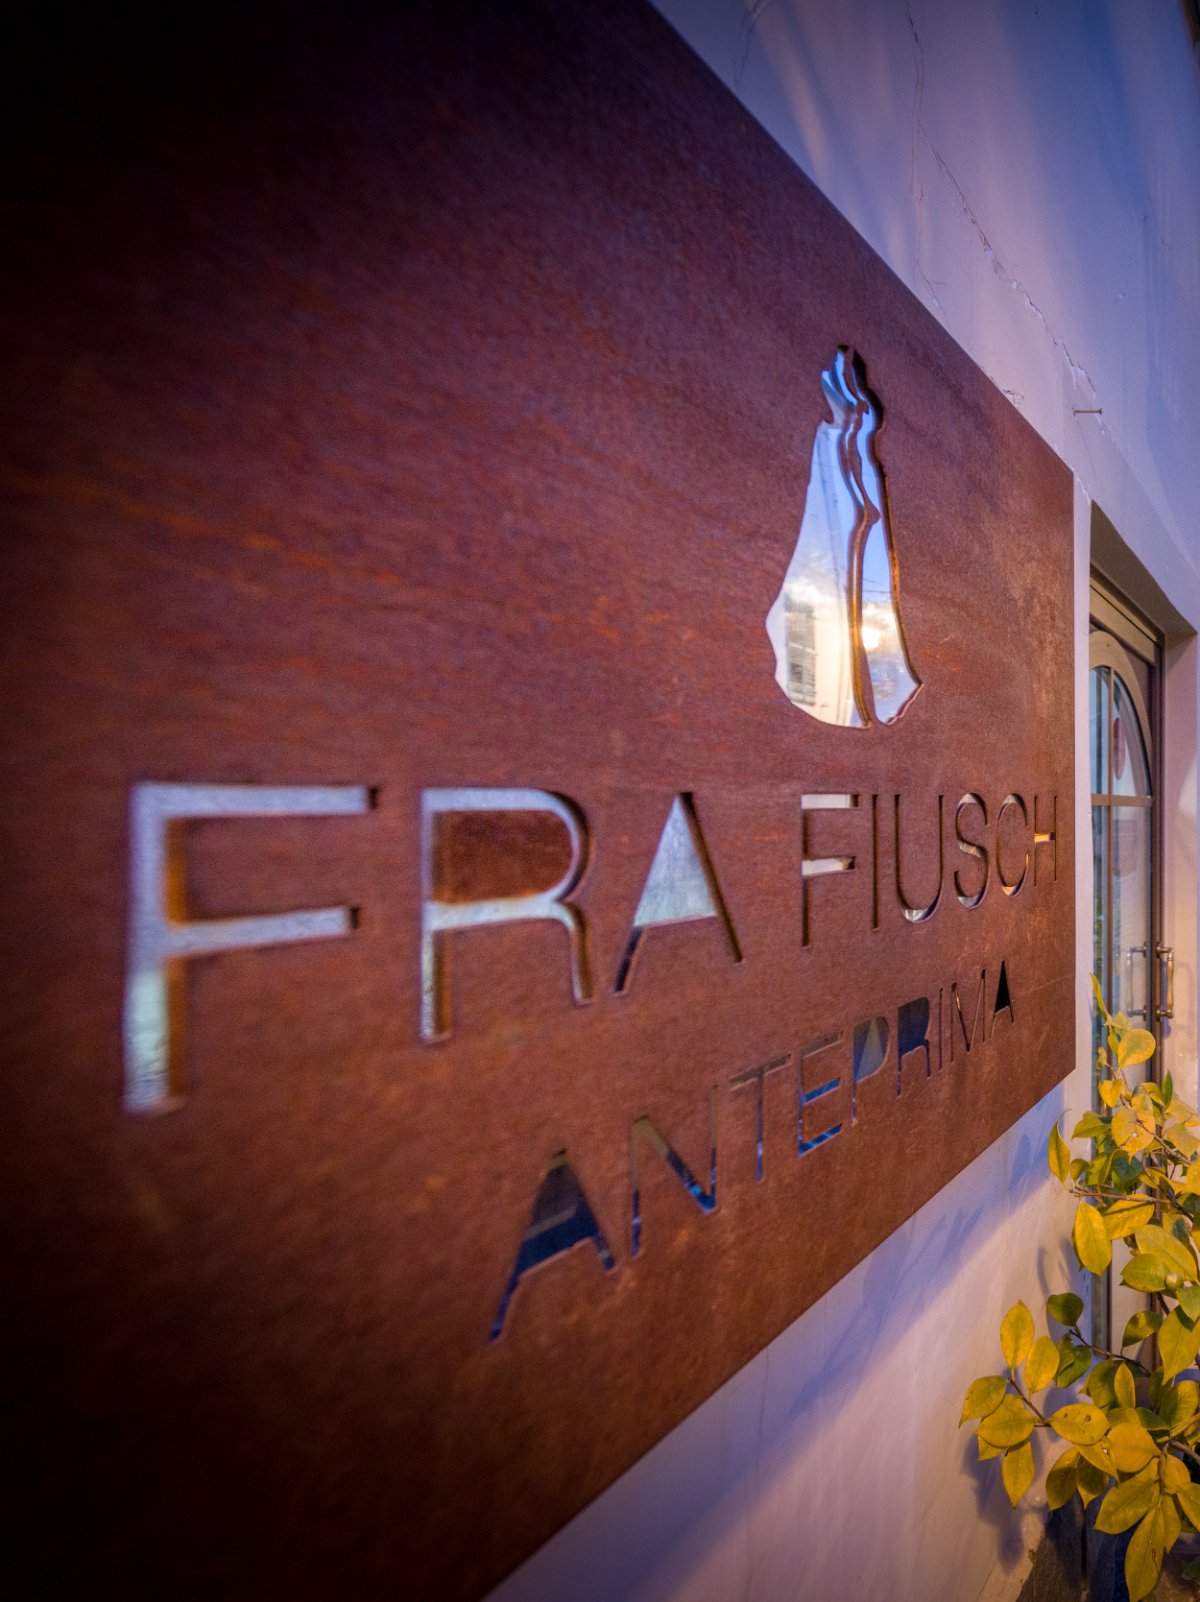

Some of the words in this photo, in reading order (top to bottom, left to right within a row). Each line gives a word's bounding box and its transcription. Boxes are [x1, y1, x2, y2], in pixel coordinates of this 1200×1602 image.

[123, 782, 743, 1114] FRA
[800, 792, 1058, 947] FIUSCH
[489, 959, 1015, 1341] ANTEPRIMA
